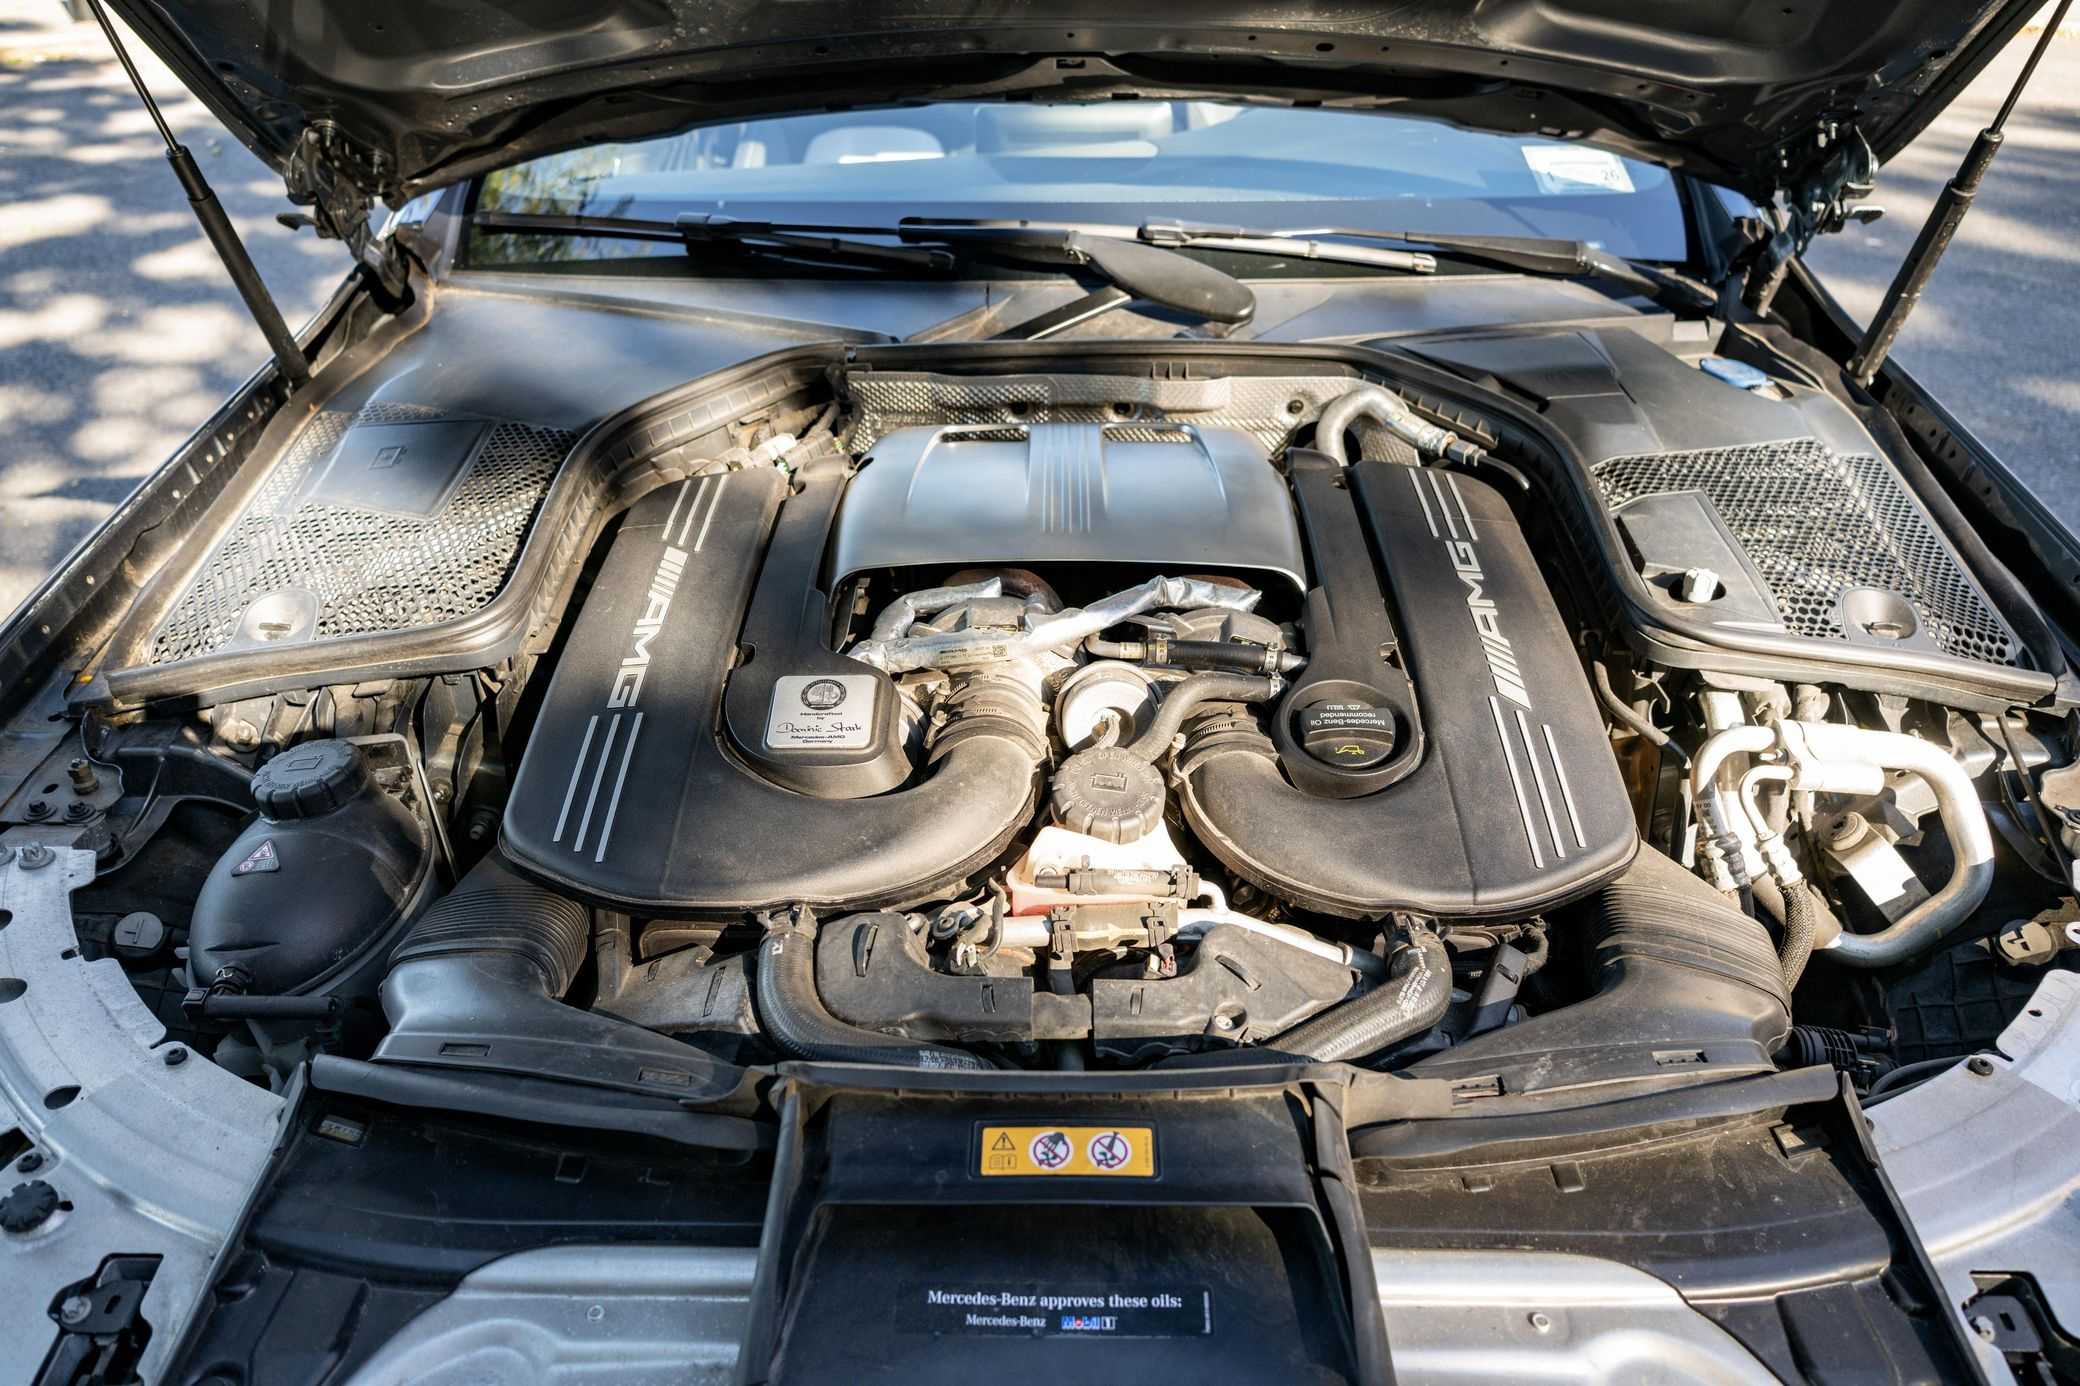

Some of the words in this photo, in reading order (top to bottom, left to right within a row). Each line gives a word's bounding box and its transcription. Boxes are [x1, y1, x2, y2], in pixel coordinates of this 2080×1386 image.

[1445, 541, 1512, 650] AMG
[607, 588, 674, 708] AMG
[776, 722, 822, 734] Dominic
[1324, 718, 1386, 726] Mercedes-Benz
[1098, 752, 1120, 760] OPEN
[927, 1290, 1036, 1306] Mercedes-Benz
[1040, 1294, 1105, 1310] approves
[1108, 1294, 1148, 1308] these
[1151, 1294, 1182, 1308] oils:
[966, 1314, 1046, 1328] Mercedes-Benz
[1061, 1316, 1100, 1330] Mobil
